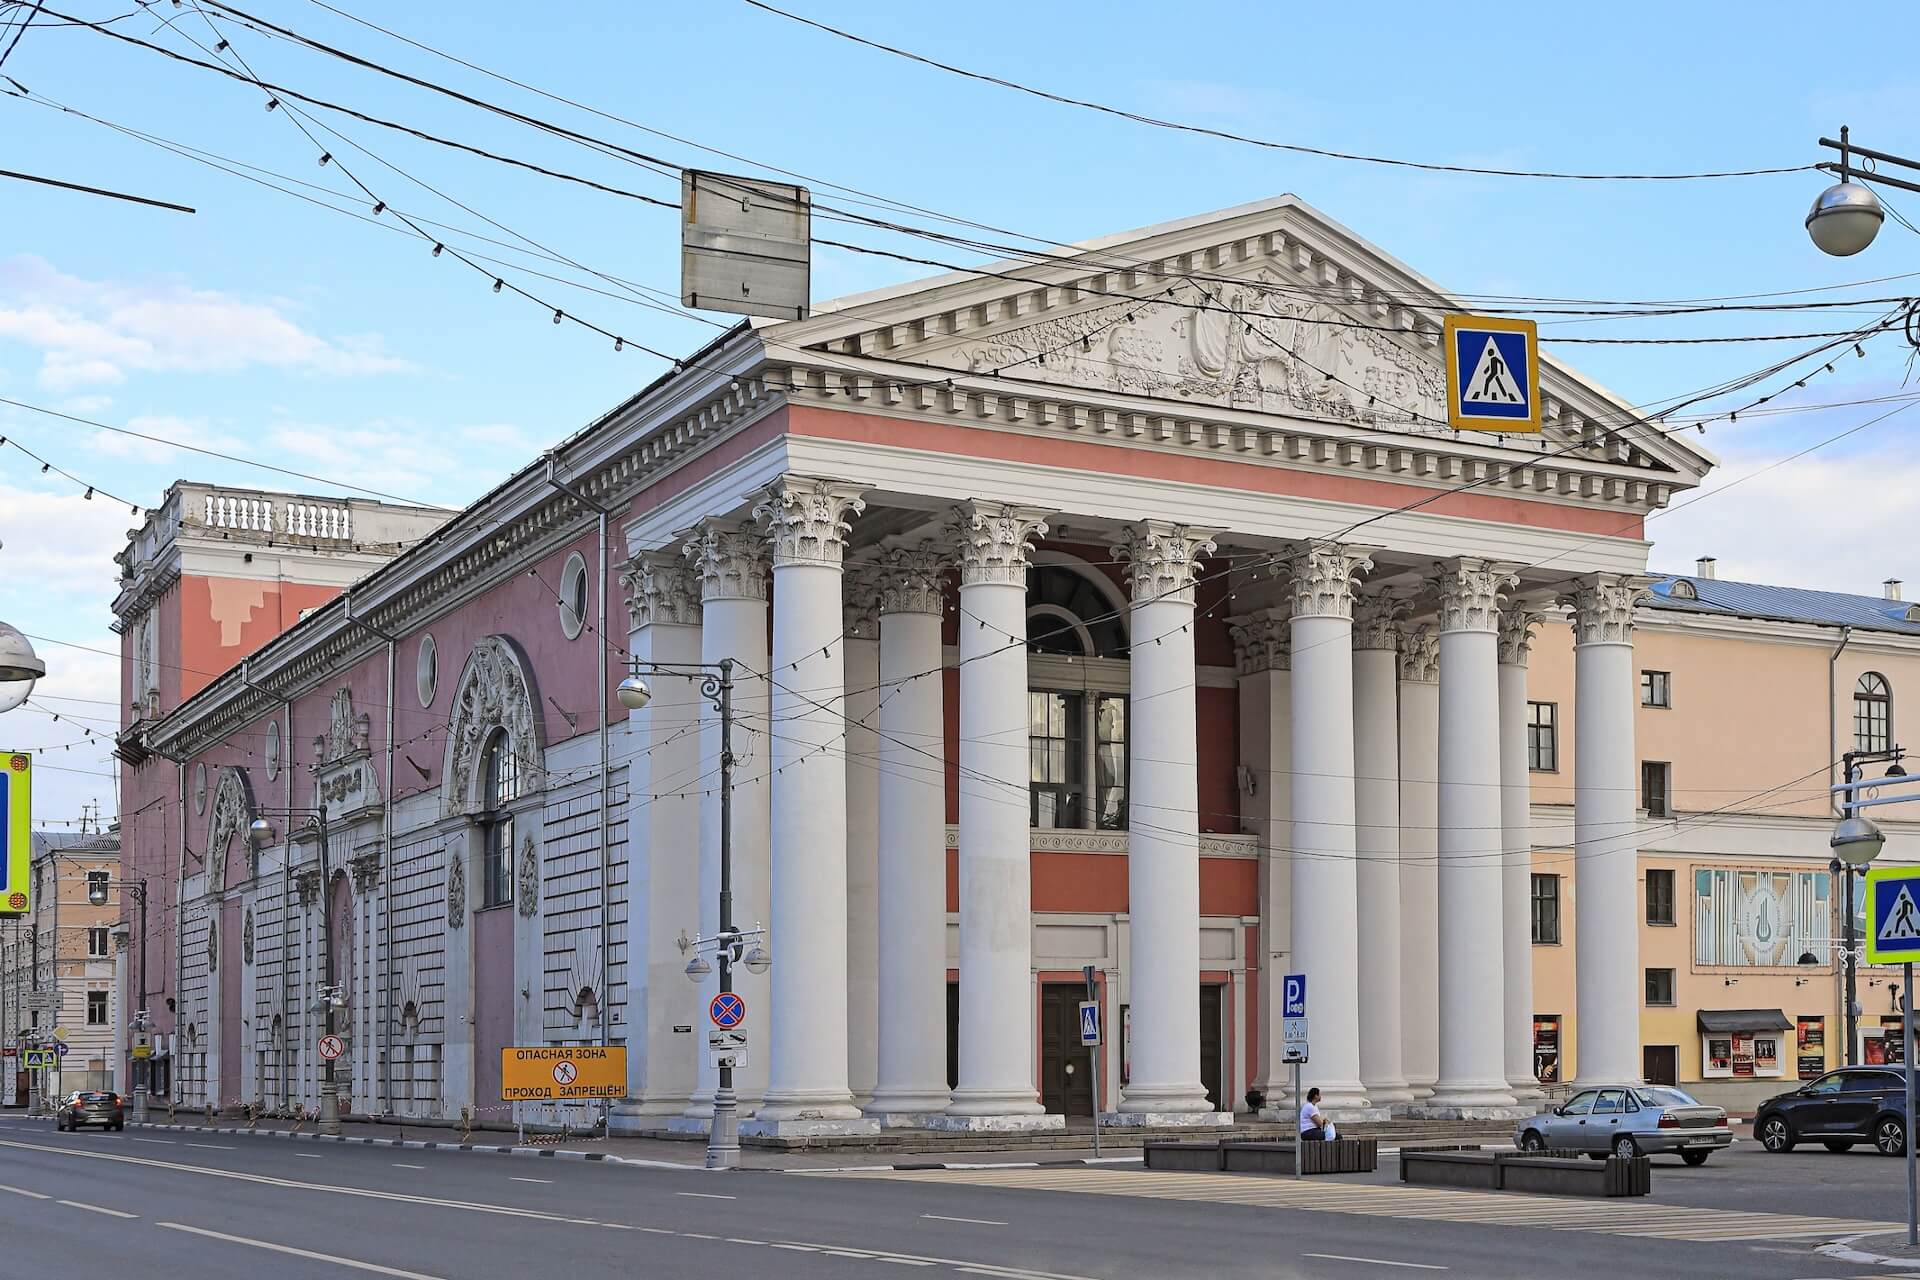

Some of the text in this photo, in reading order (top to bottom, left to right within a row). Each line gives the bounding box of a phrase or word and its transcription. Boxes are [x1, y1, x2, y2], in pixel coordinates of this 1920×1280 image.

[1287, 980, 1300, 1014] P
[517, 1049, 607, 1060] ОПАСНАЯ ЗОНА
[505, 1085, 625, 1099] ПРОХОД ЗАПРЕЩЁН!
